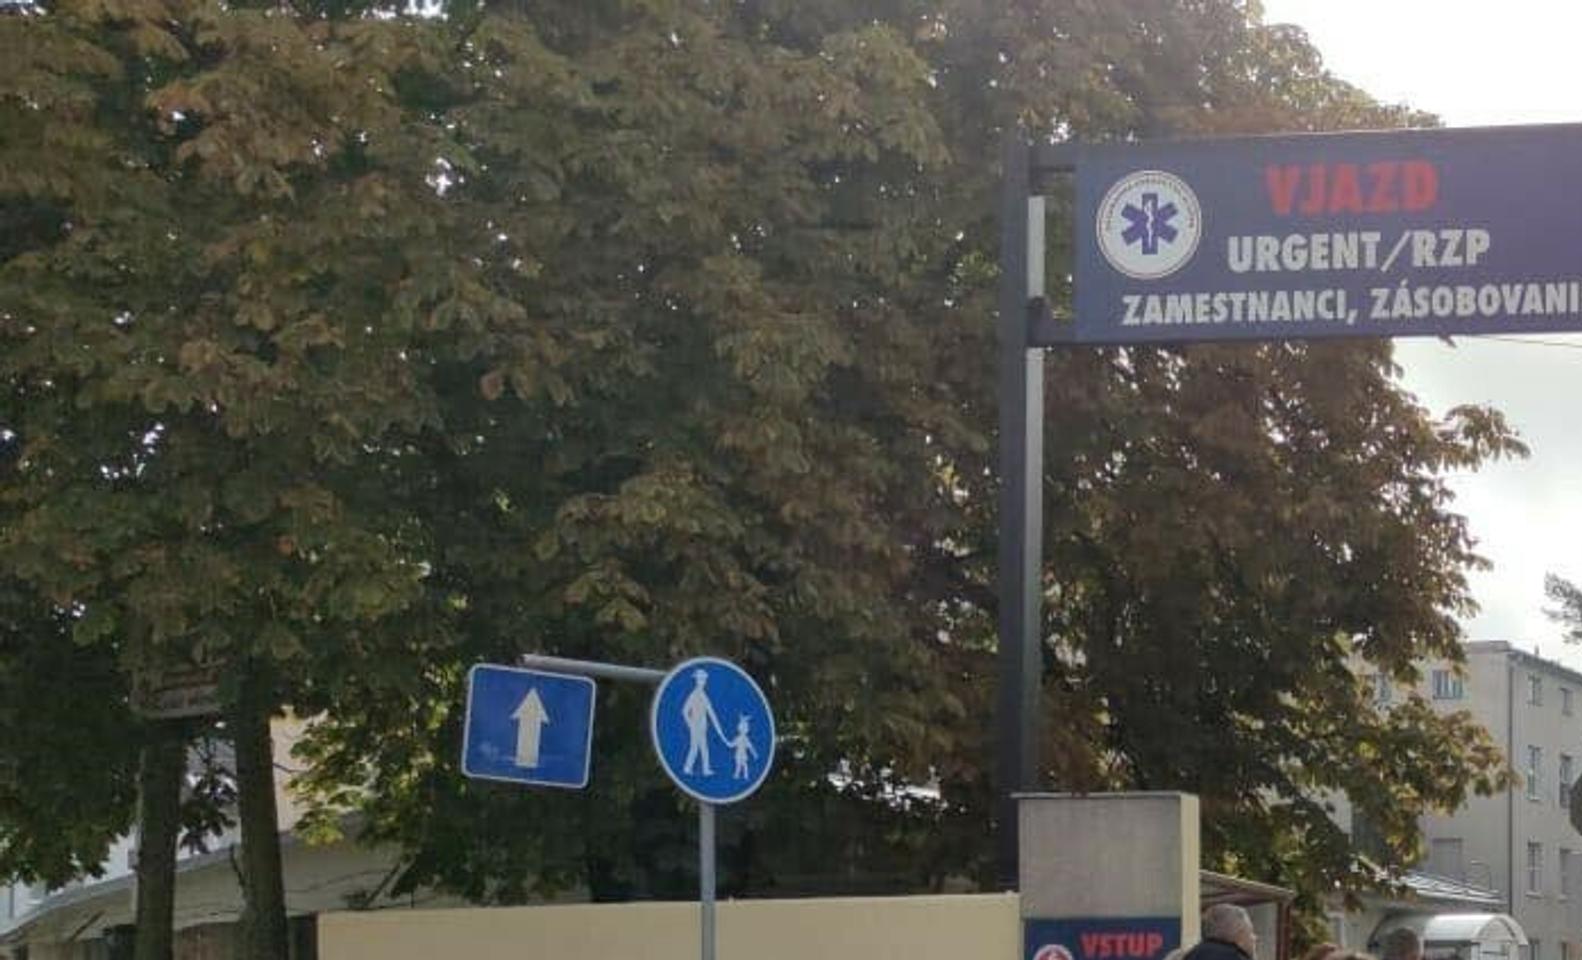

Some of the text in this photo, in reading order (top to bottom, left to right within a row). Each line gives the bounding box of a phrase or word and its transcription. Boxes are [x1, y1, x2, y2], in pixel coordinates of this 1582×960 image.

[1265, 160, 1440, 216] VJAZD
[1227, 229, 1491, 273] URGENT/RZP
[1121, 288, 1358, 327] ZAMESTNANCI,
[1081, 932, 1164, 958] VSTUP
